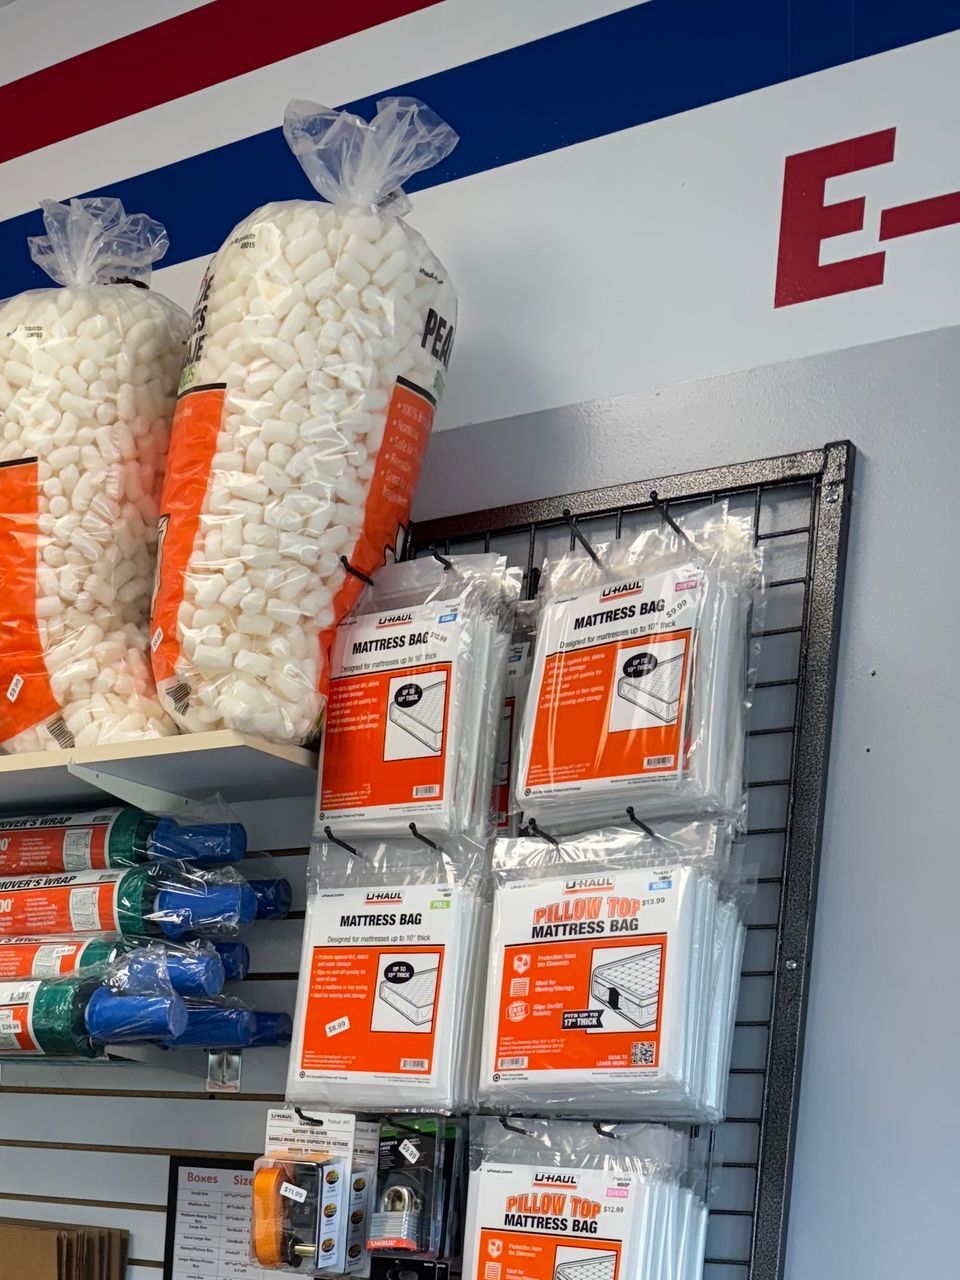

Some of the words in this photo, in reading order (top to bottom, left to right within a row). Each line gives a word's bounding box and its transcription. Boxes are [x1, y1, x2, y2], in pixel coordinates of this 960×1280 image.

[574, 605, 636, 630] MATTRESS
[640, 599, 665, 615] BAG
[666, 599, 688, 618] $9.99
[38, 816, 73, 826] WRAP
[43, 875, 77, 886] WRAP
[642, 897, 665, 906] $13.99
[340, 913, 396, 927] MATTRESS
[400, 912, 422, 925] BAG
[533, 897, 603, 925] PILLOW
[607, 897, 640, 917] TOP
[532, 920, 604, 939] MATTRESS
[610, 918, 638, 932] BAG
[564, 1018, 576, 1026] 17"
[577, 1018, 597, 1026] THICK
[283, 1185, 303, 1200] $11.99
[505, 1192, 567, 1216] PILLOW
[570, 1196, 601, 1220] TOP
[504, 1213, 568, 1231] MATTRESS
[572, 1219, 598, 1234] BAG
